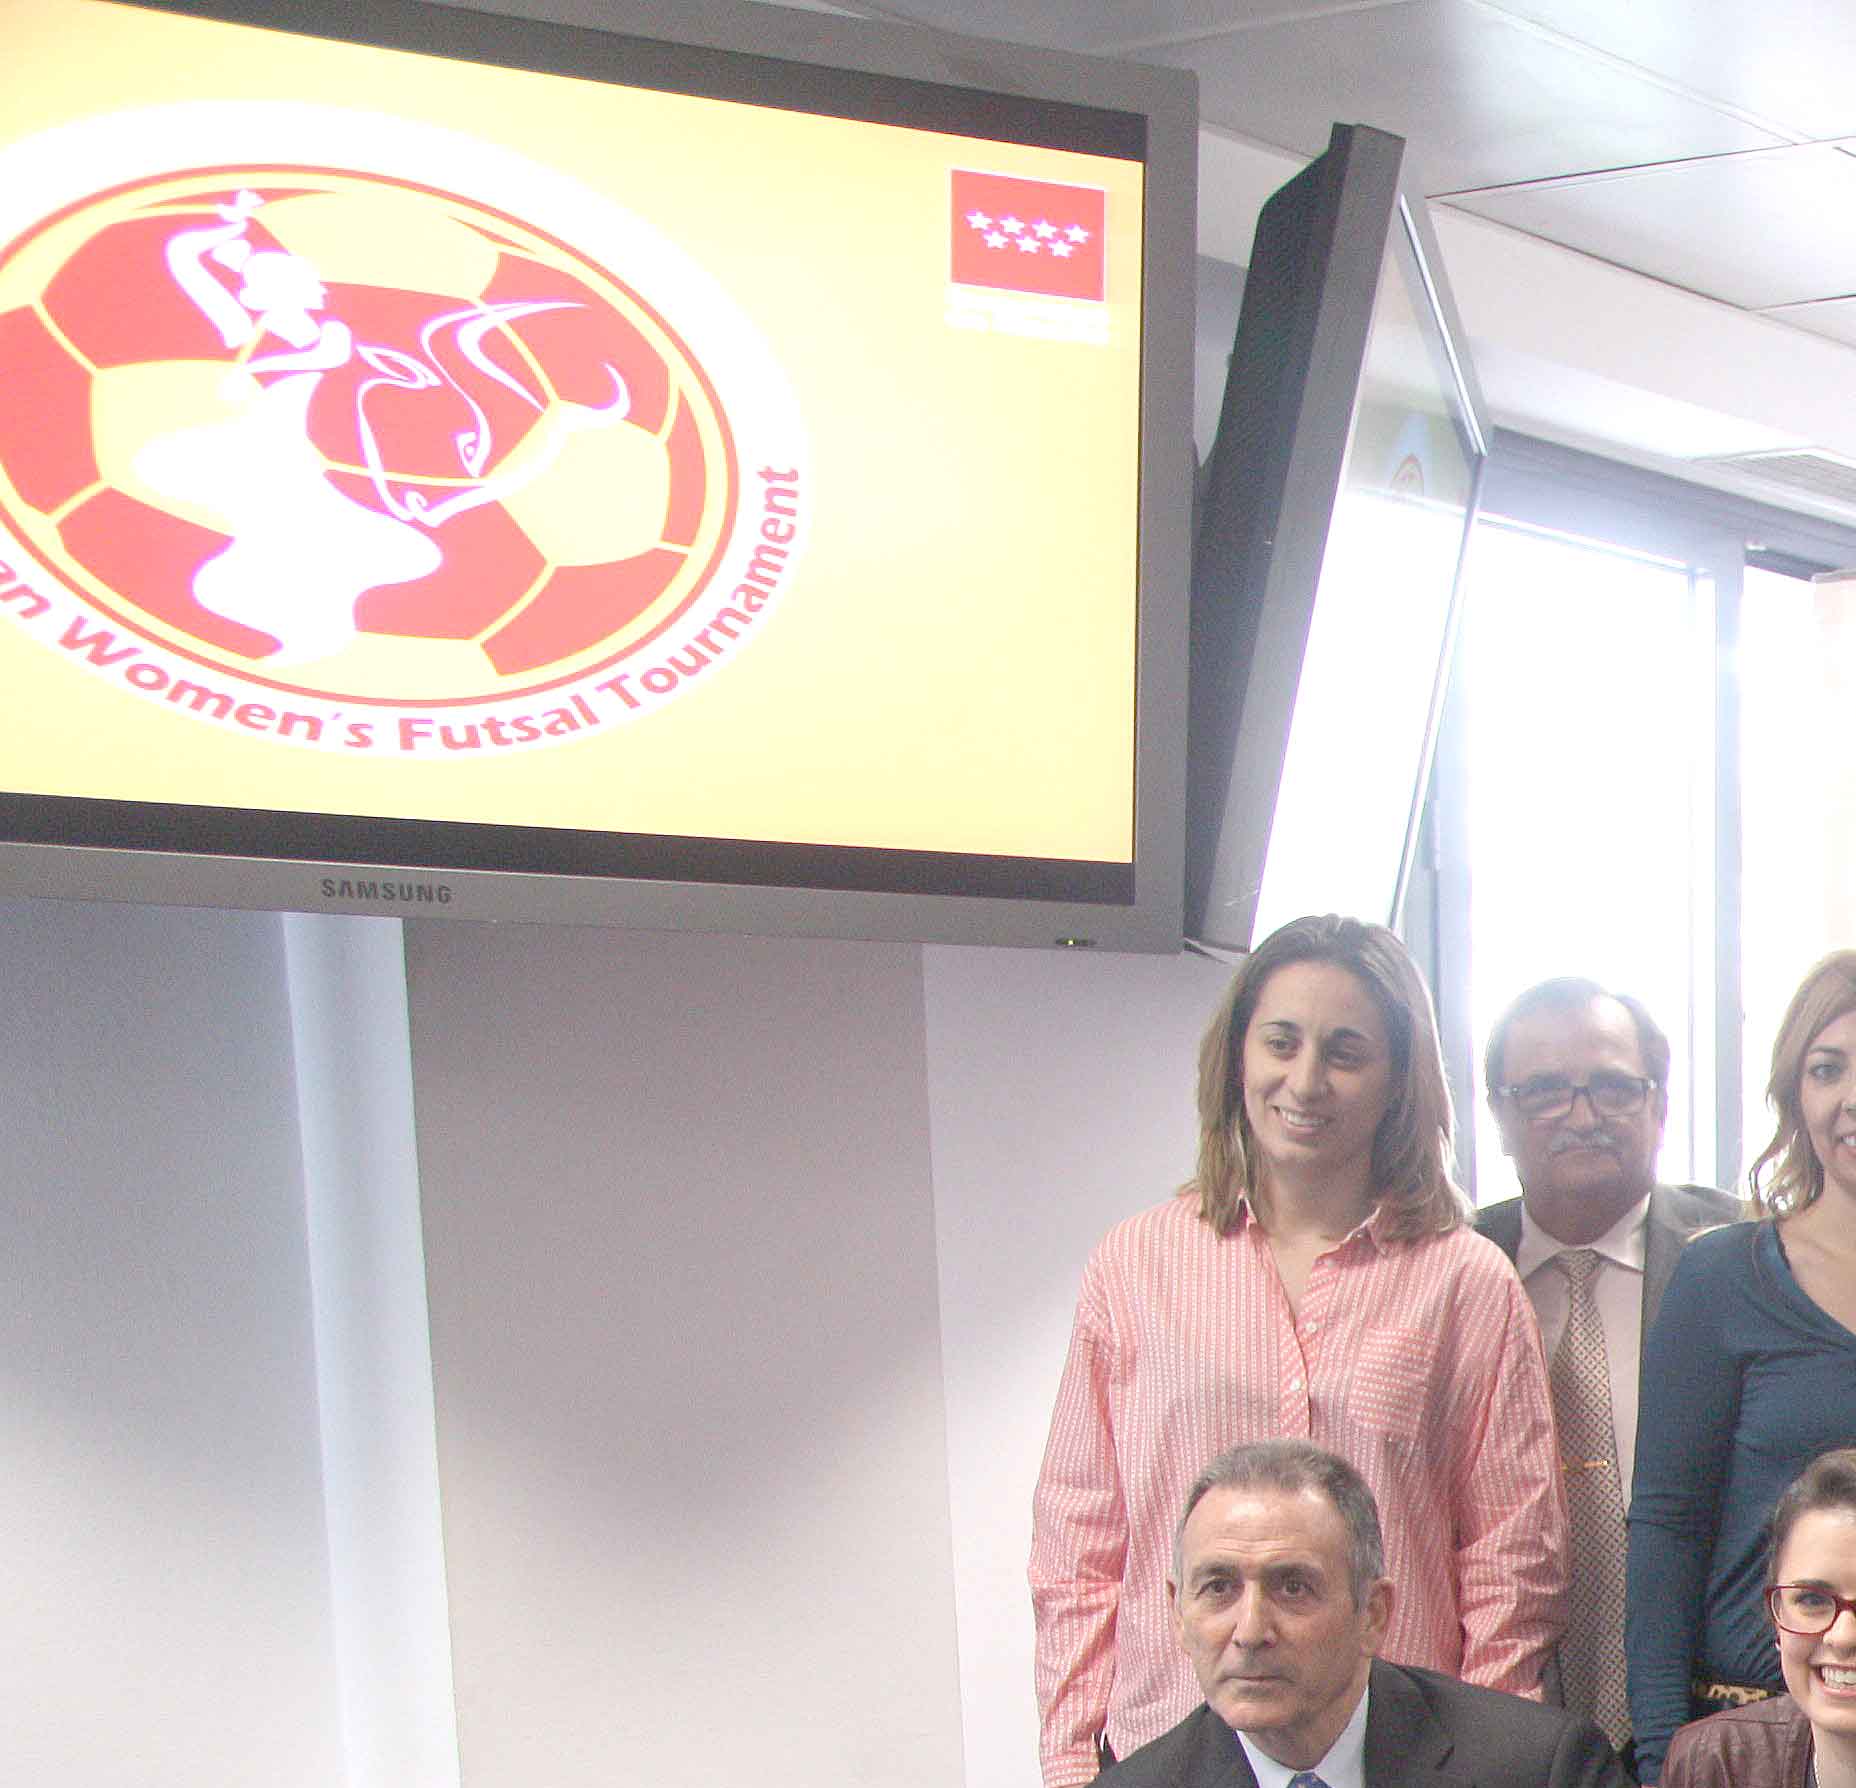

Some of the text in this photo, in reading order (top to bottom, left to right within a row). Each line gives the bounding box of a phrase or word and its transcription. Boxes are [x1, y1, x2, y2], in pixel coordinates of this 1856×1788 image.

[58, 616, 374, 749] Women's
[399, 694, 601, 751] Futsal
[595, 466, 799, 709] Tournament
[322, 878, 455, 905] SAMSUNG
